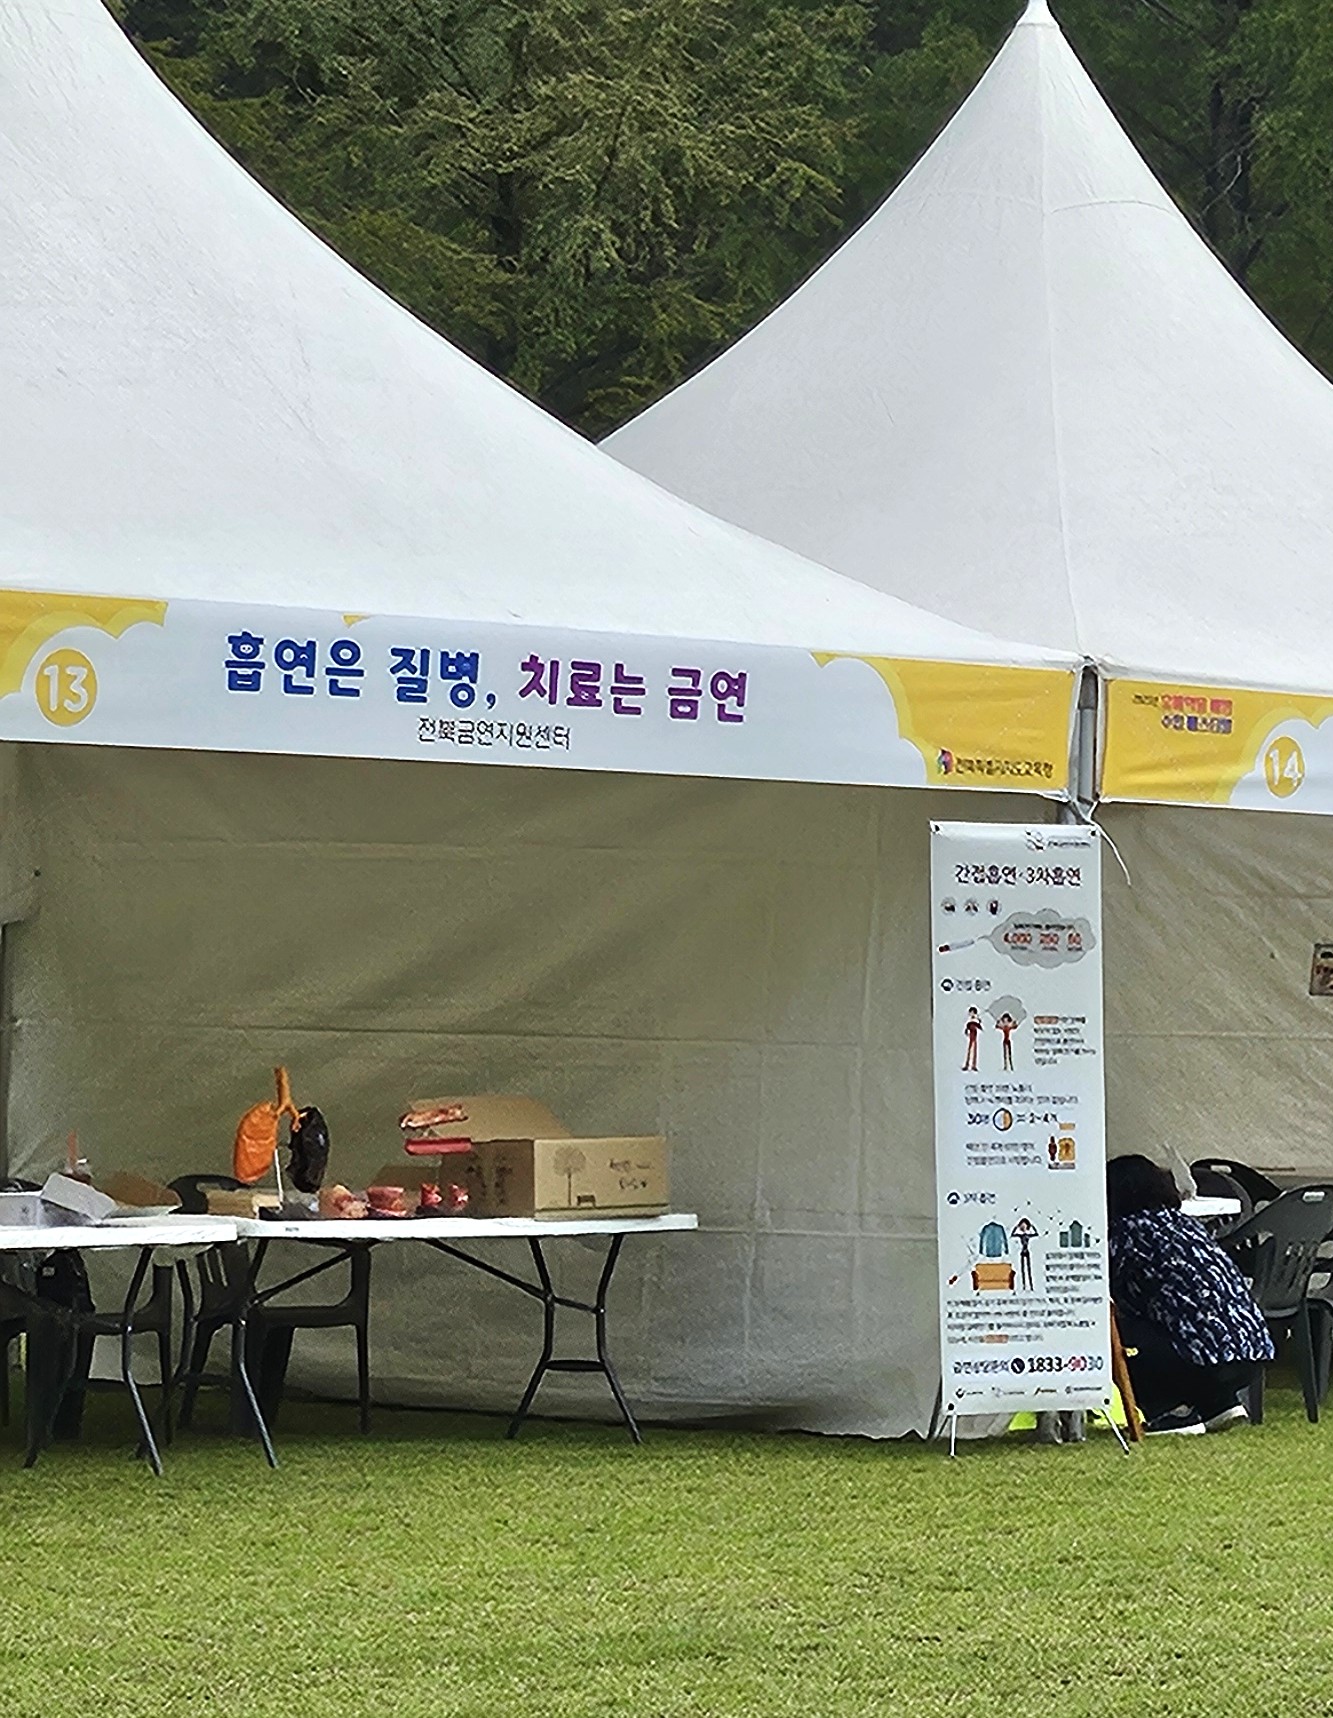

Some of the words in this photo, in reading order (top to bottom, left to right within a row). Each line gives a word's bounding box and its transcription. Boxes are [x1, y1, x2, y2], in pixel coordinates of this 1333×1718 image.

[41, 664, 89, 713] 13
[224, 630, 366, 697] 흡연은
[389, 647, 497, 710] 질병,
[519, 652, 644, 717] 치료는
[666, 667, 748, 724] 금연
[418, 717, 571, 750] 전북금연지원센터
[1268, 749, 1302, 788] 14
[1027, 1355, 1104, 1374] 1833-9030
